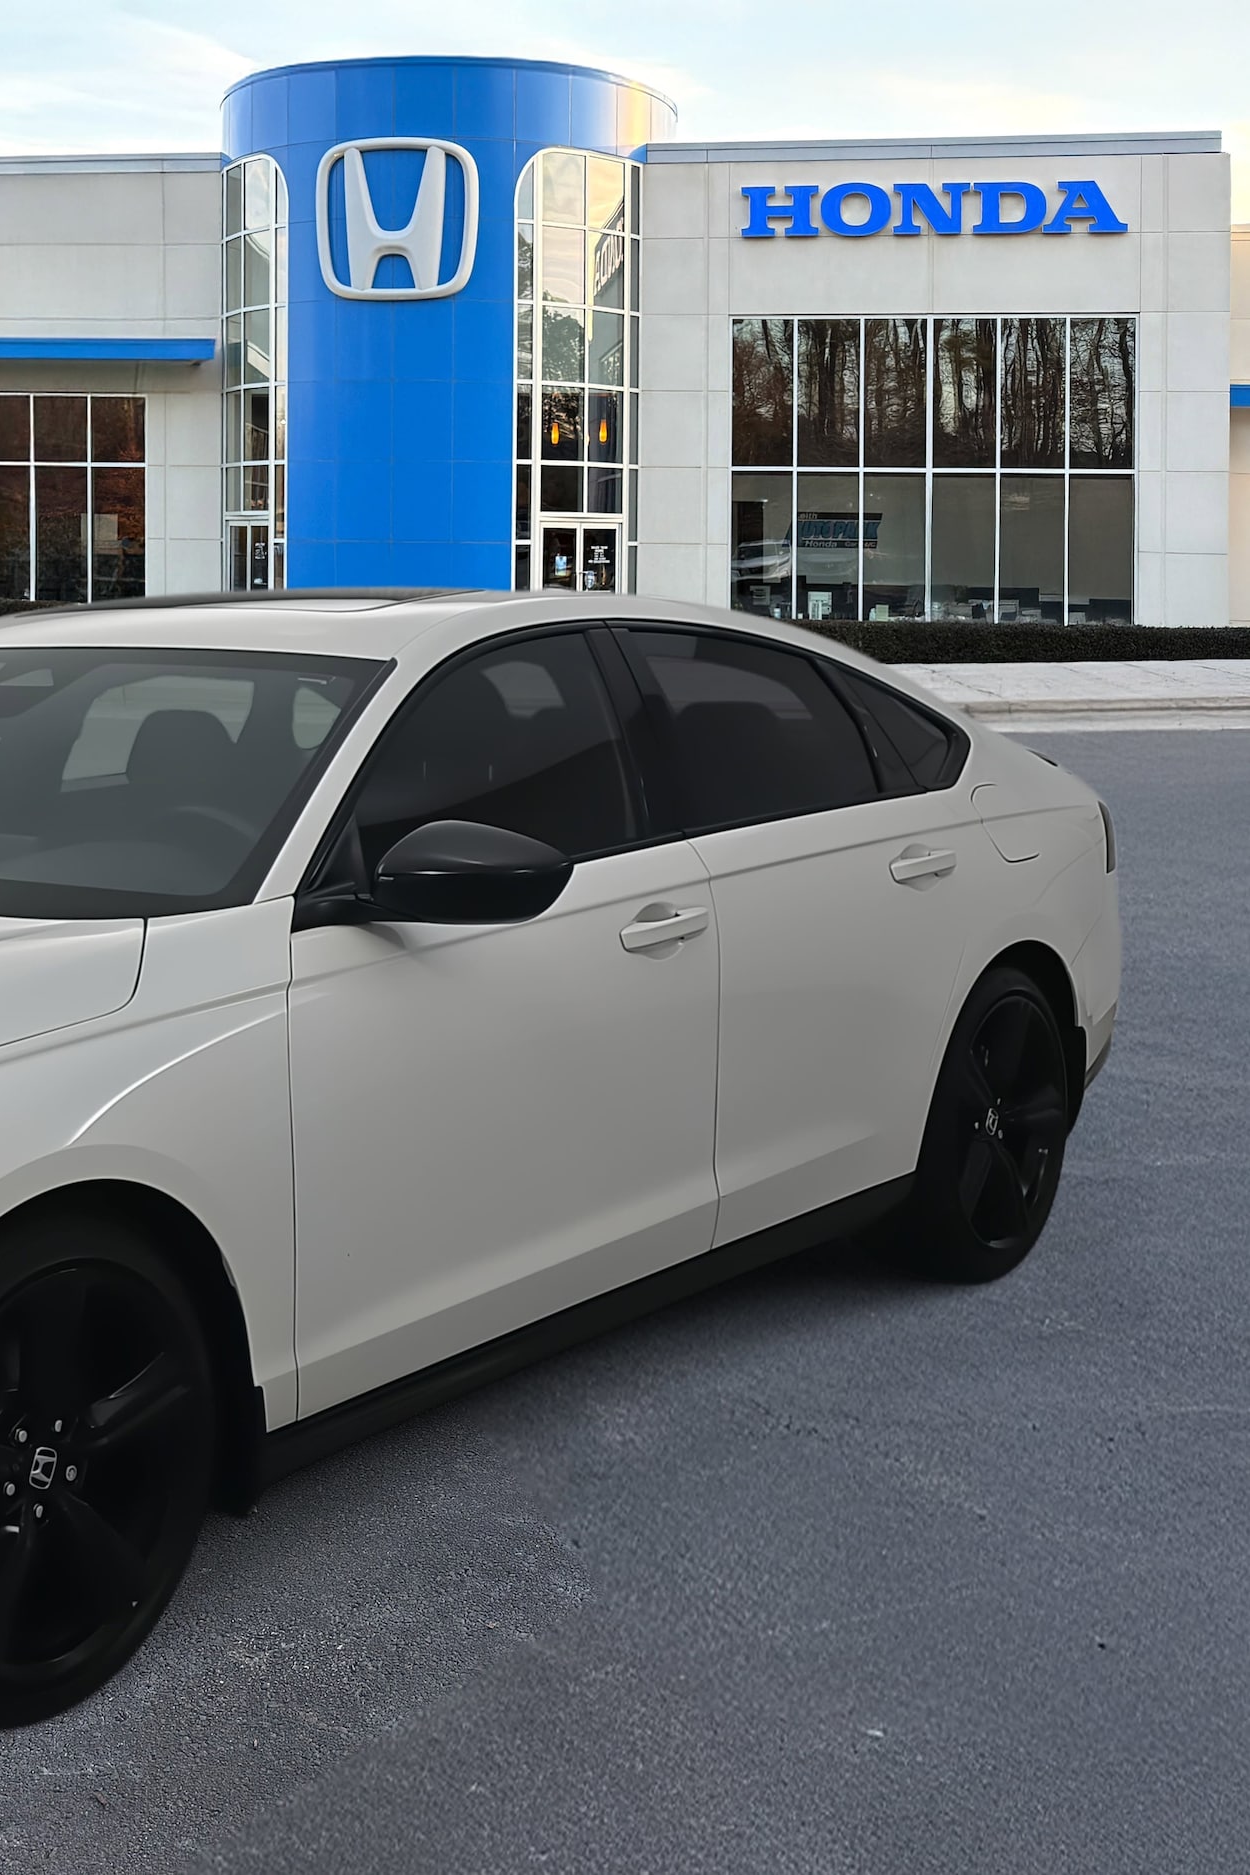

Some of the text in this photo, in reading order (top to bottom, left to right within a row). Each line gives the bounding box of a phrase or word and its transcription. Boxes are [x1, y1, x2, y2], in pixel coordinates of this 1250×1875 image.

[741, 180, 1129, 237] HONDA
[796, 512, 818, 520] eith
[804, 540, 838, 548] Honda
